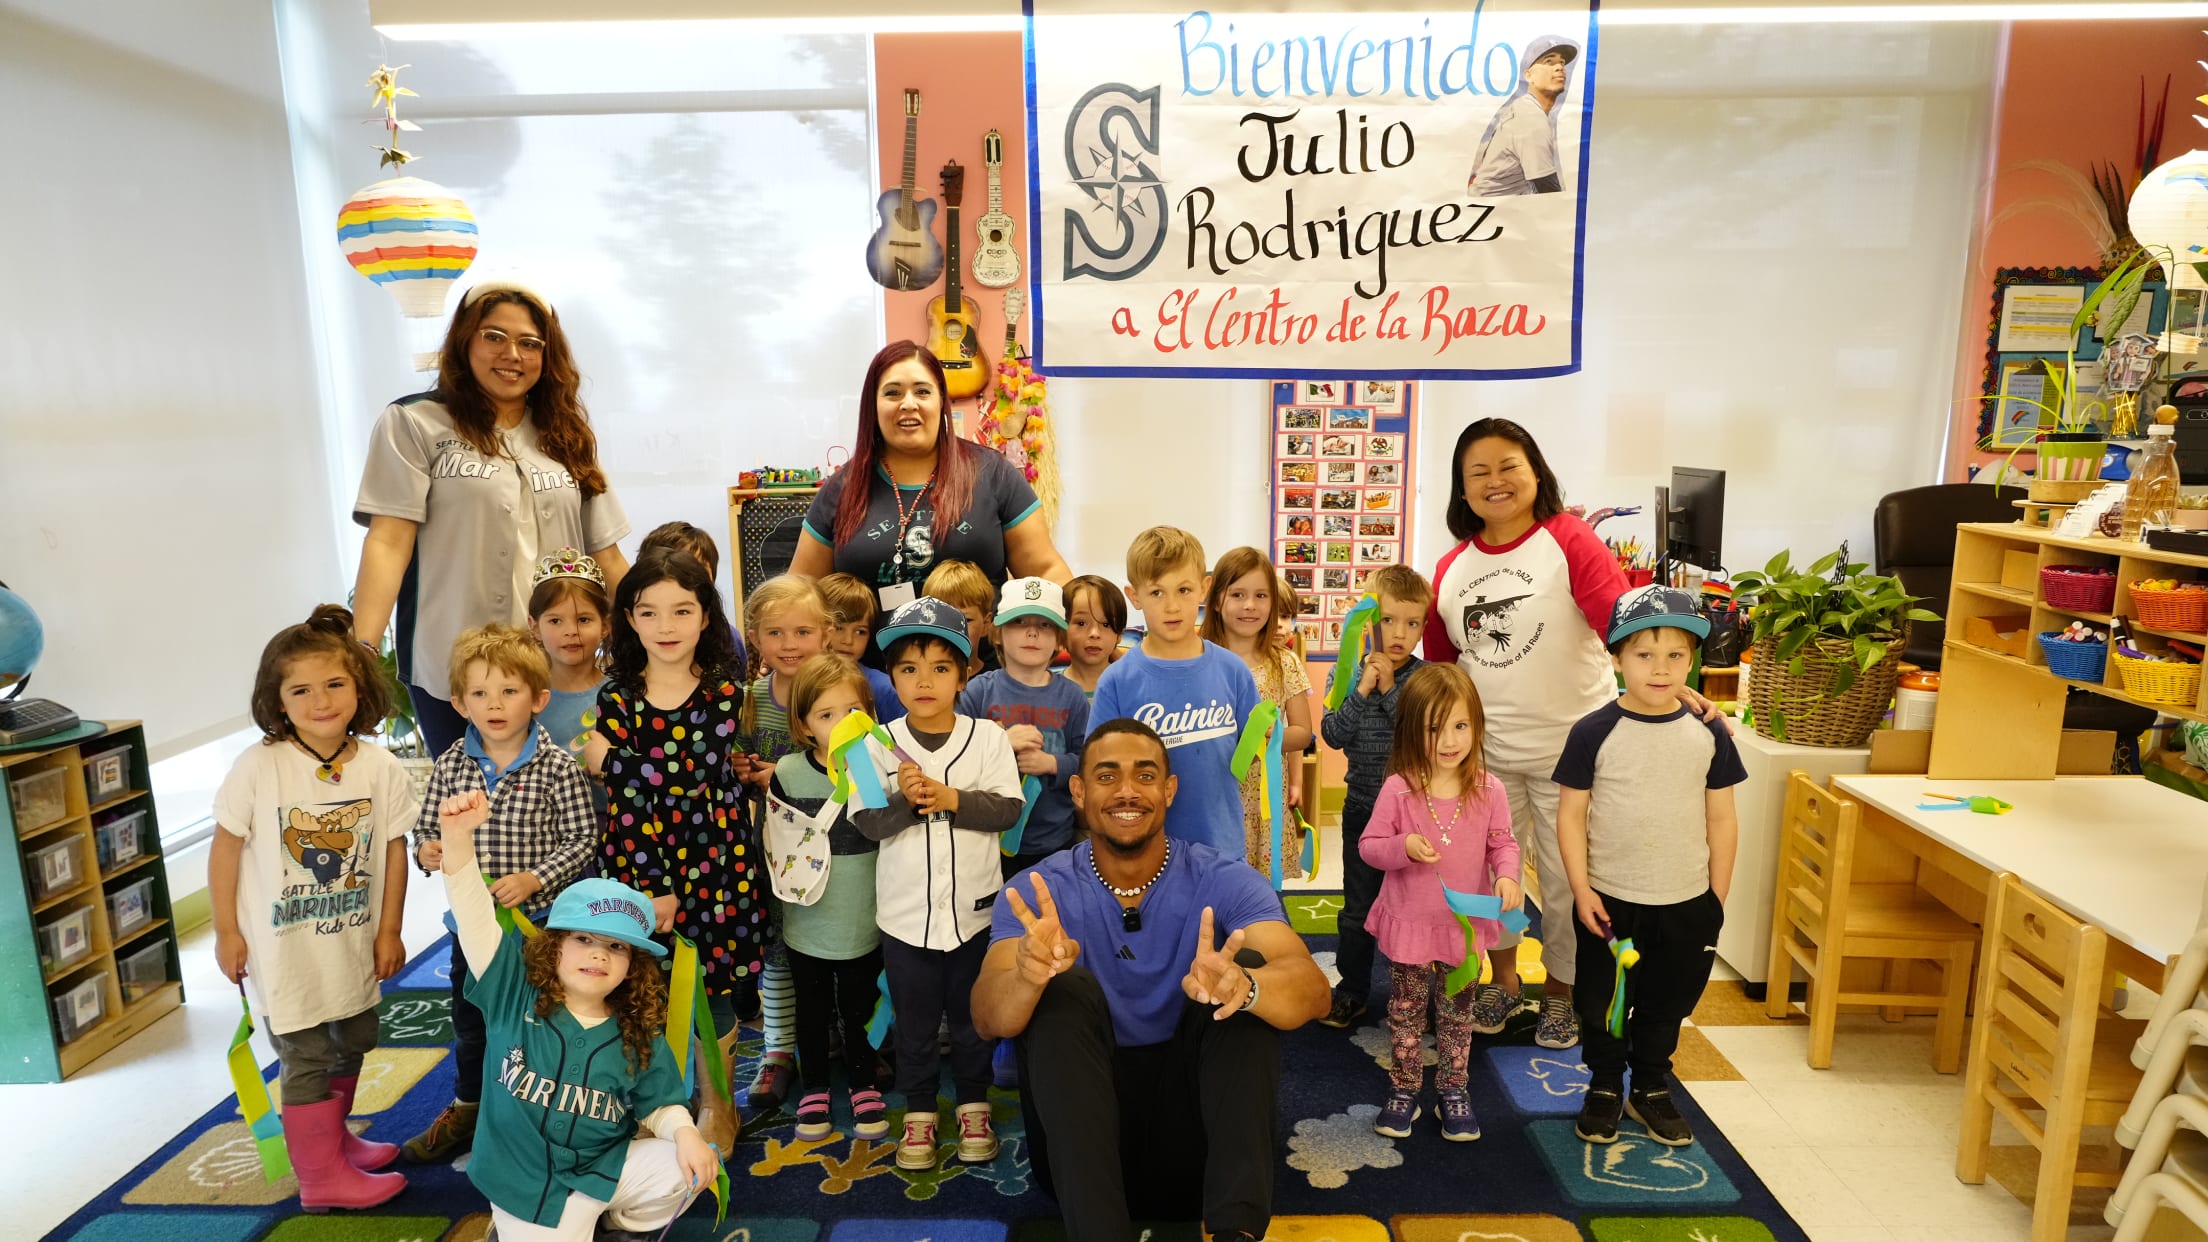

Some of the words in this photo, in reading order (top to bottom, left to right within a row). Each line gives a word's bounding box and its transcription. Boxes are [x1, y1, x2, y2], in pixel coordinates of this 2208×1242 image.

[1173, 0, 1517, 101] Bienvenido
[1236, 108, 1416, 184] Julio
[1176, 186, 1504, 299] Rodriguez
[1110, 305, 1141, 338] a
[1153, 288, 1199, 354] El
[1202, 286, 1319, 349] Centro
[1325, 311, 1366, 342] de
[1376, 290, 1409, 341] la
[1420, 285, 1547, 356] Raza
[867, 510, 973, 541] SETTE
[1469, 569, 1500, 589] CENTRO
[1515, 569, 1534, 585] RAZA
[1489, 659, 1514, 669] People
[1522, 645, 1532, 656] All
[1528, 622, 1545, 646] Races
[1133, 699, 1237, 735] Rainier
[274, 883, 369, 926] MARINER
[587, 897, 650, 933] MARINERS
